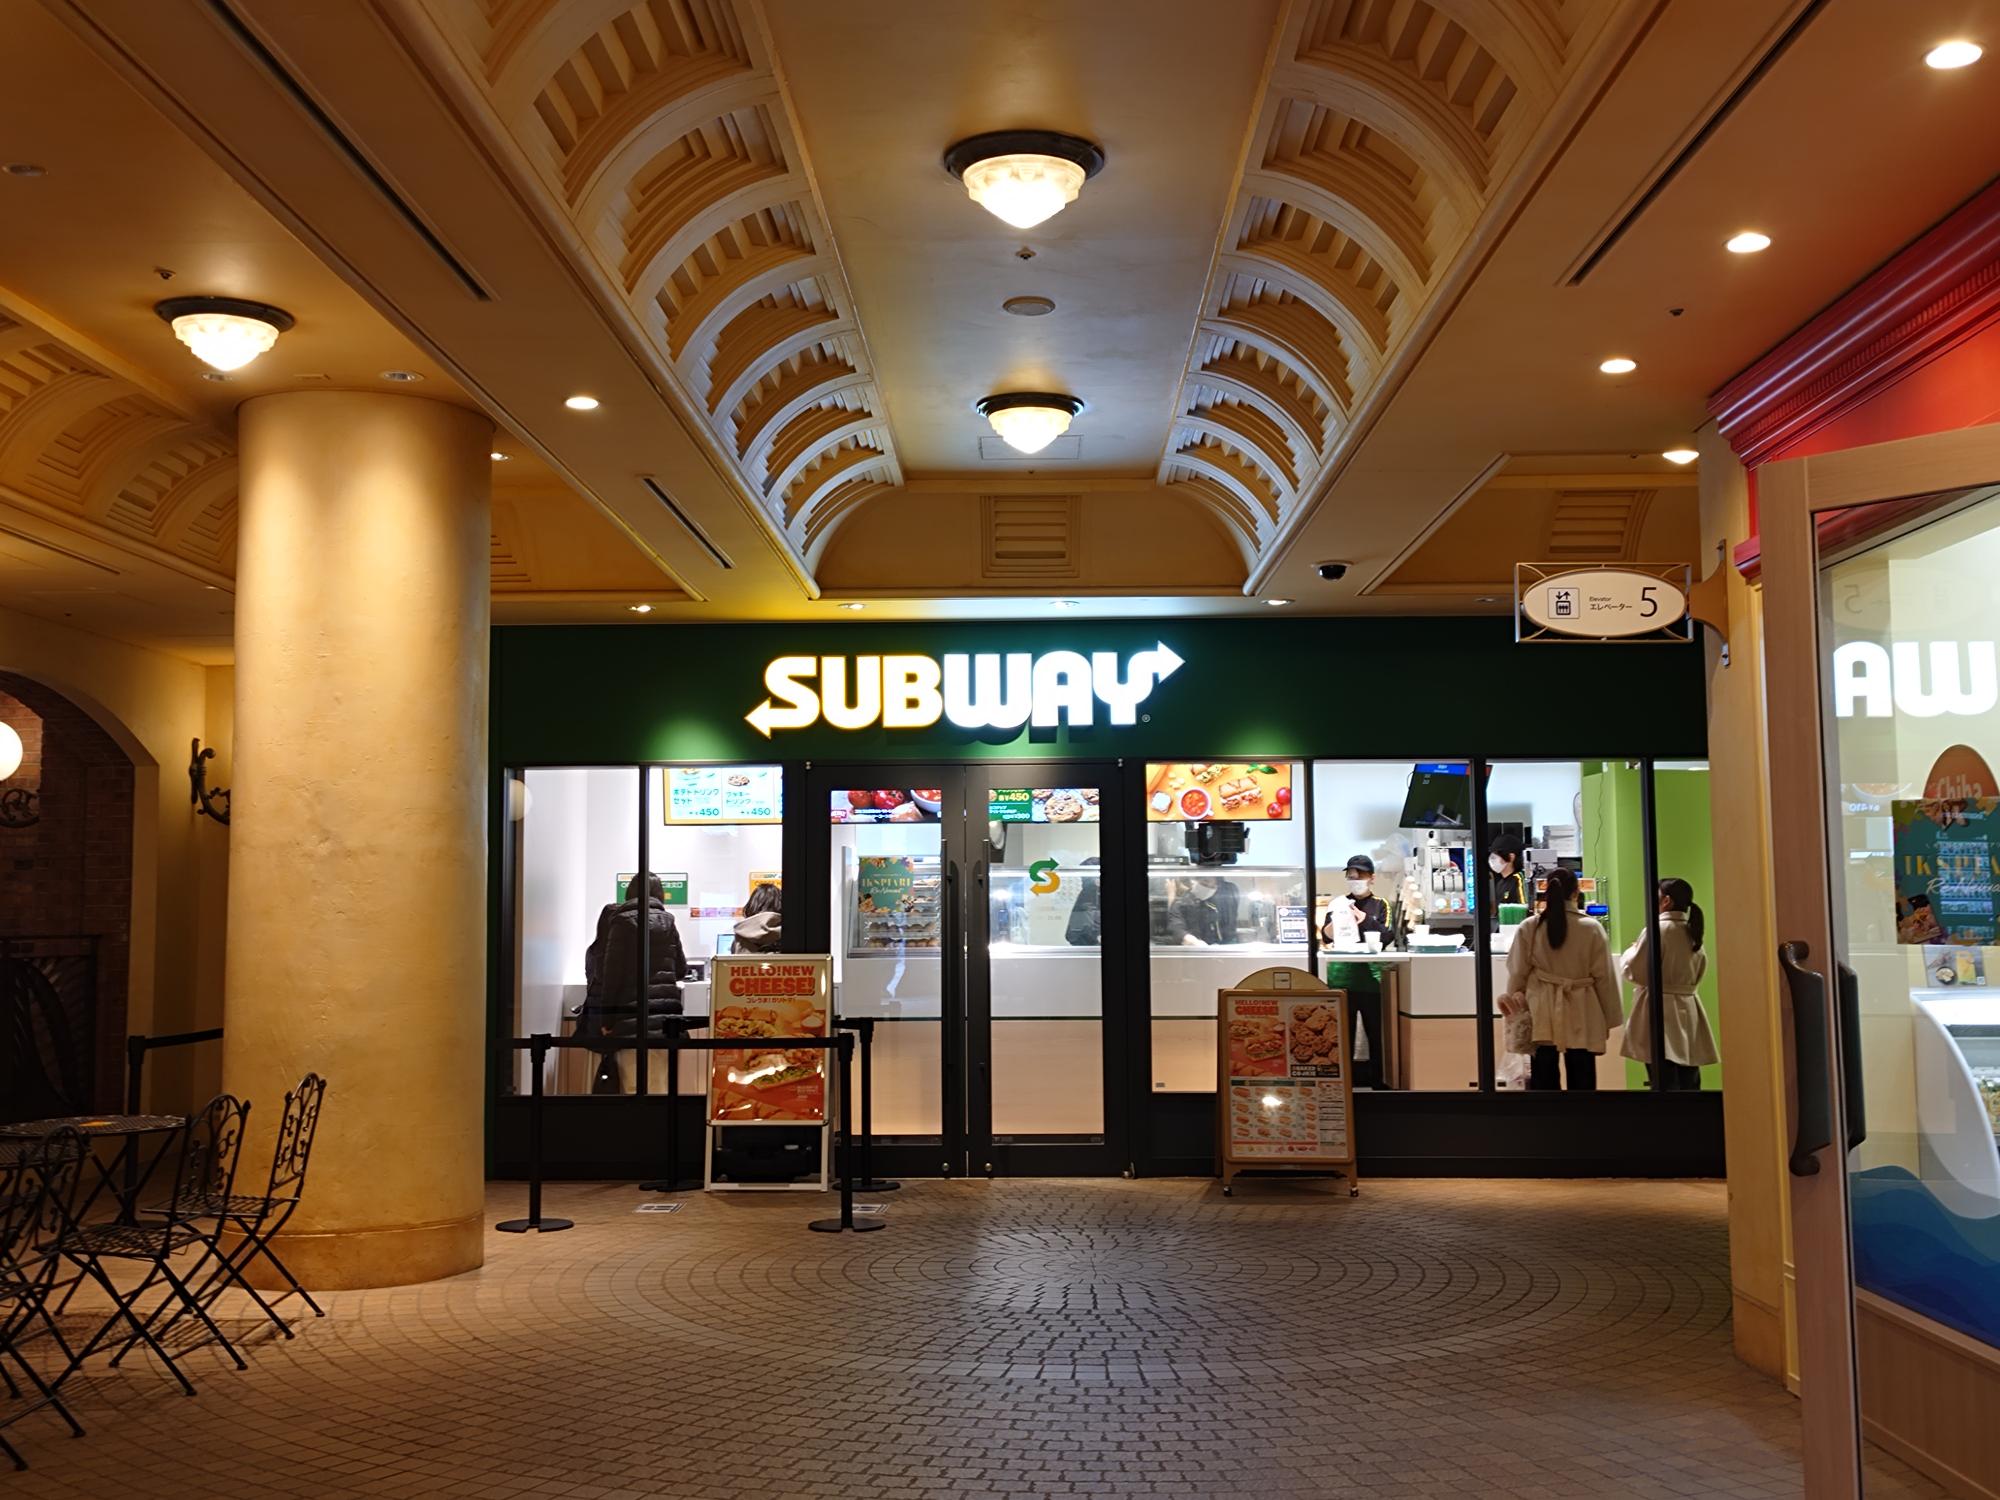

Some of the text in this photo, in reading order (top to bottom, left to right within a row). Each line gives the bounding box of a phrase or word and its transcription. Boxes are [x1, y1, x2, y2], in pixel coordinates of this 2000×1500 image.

[1590, 603, 1633, 611] エレベーター
[1640, 587, 1658, 617] 5
[744, 640, 1186, 739] SUBWAY
[729, 977, 816, 996] CHEESE!
